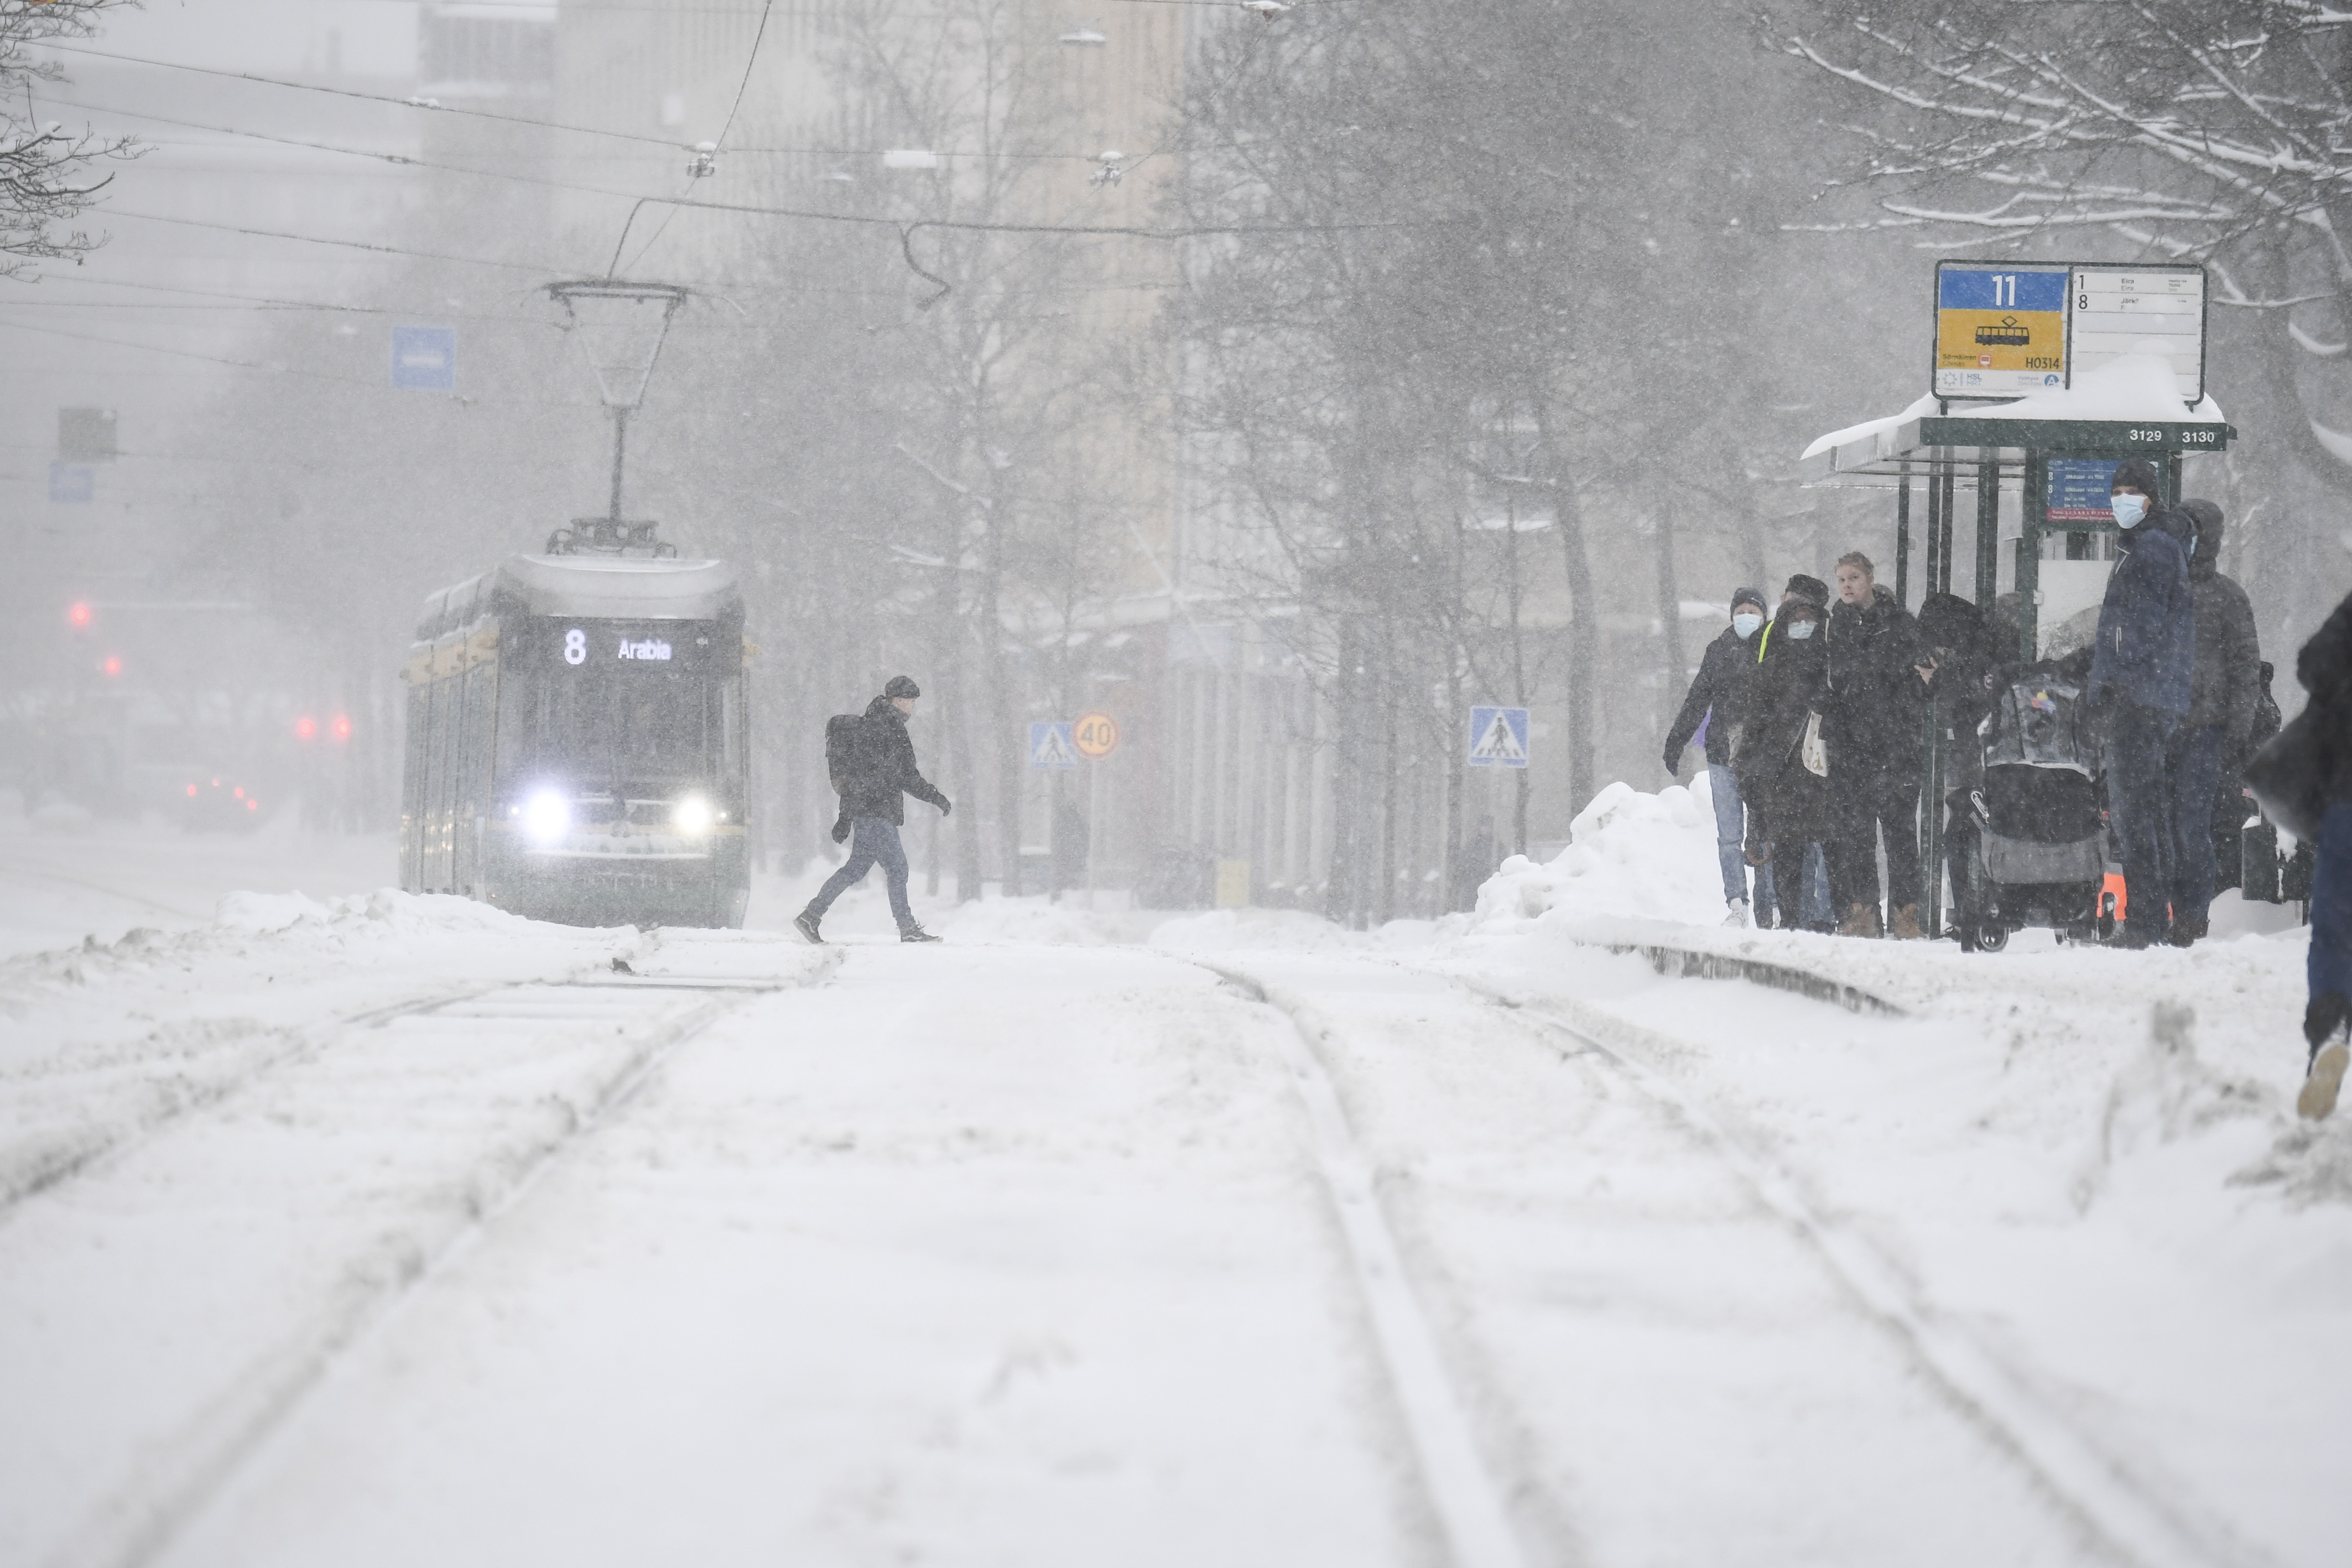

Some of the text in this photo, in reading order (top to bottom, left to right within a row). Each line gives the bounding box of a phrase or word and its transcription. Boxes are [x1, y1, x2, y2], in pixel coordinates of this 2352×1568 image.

[2079, 275, 2084, 289] 1
[1992, 275, 2016, 306] 11
[2079, 294, 2088, 309] 8
[2026, 357, 2060, 369] H0314
[2130, 430, 2215, 442] 3129 3130
[2048, 472, 2053, 481] 8
[2048, 485, 2053, 494] 8
[564, 629, 672, 664] 8 Arabia
[1080, 723, 1111, 747] 40
